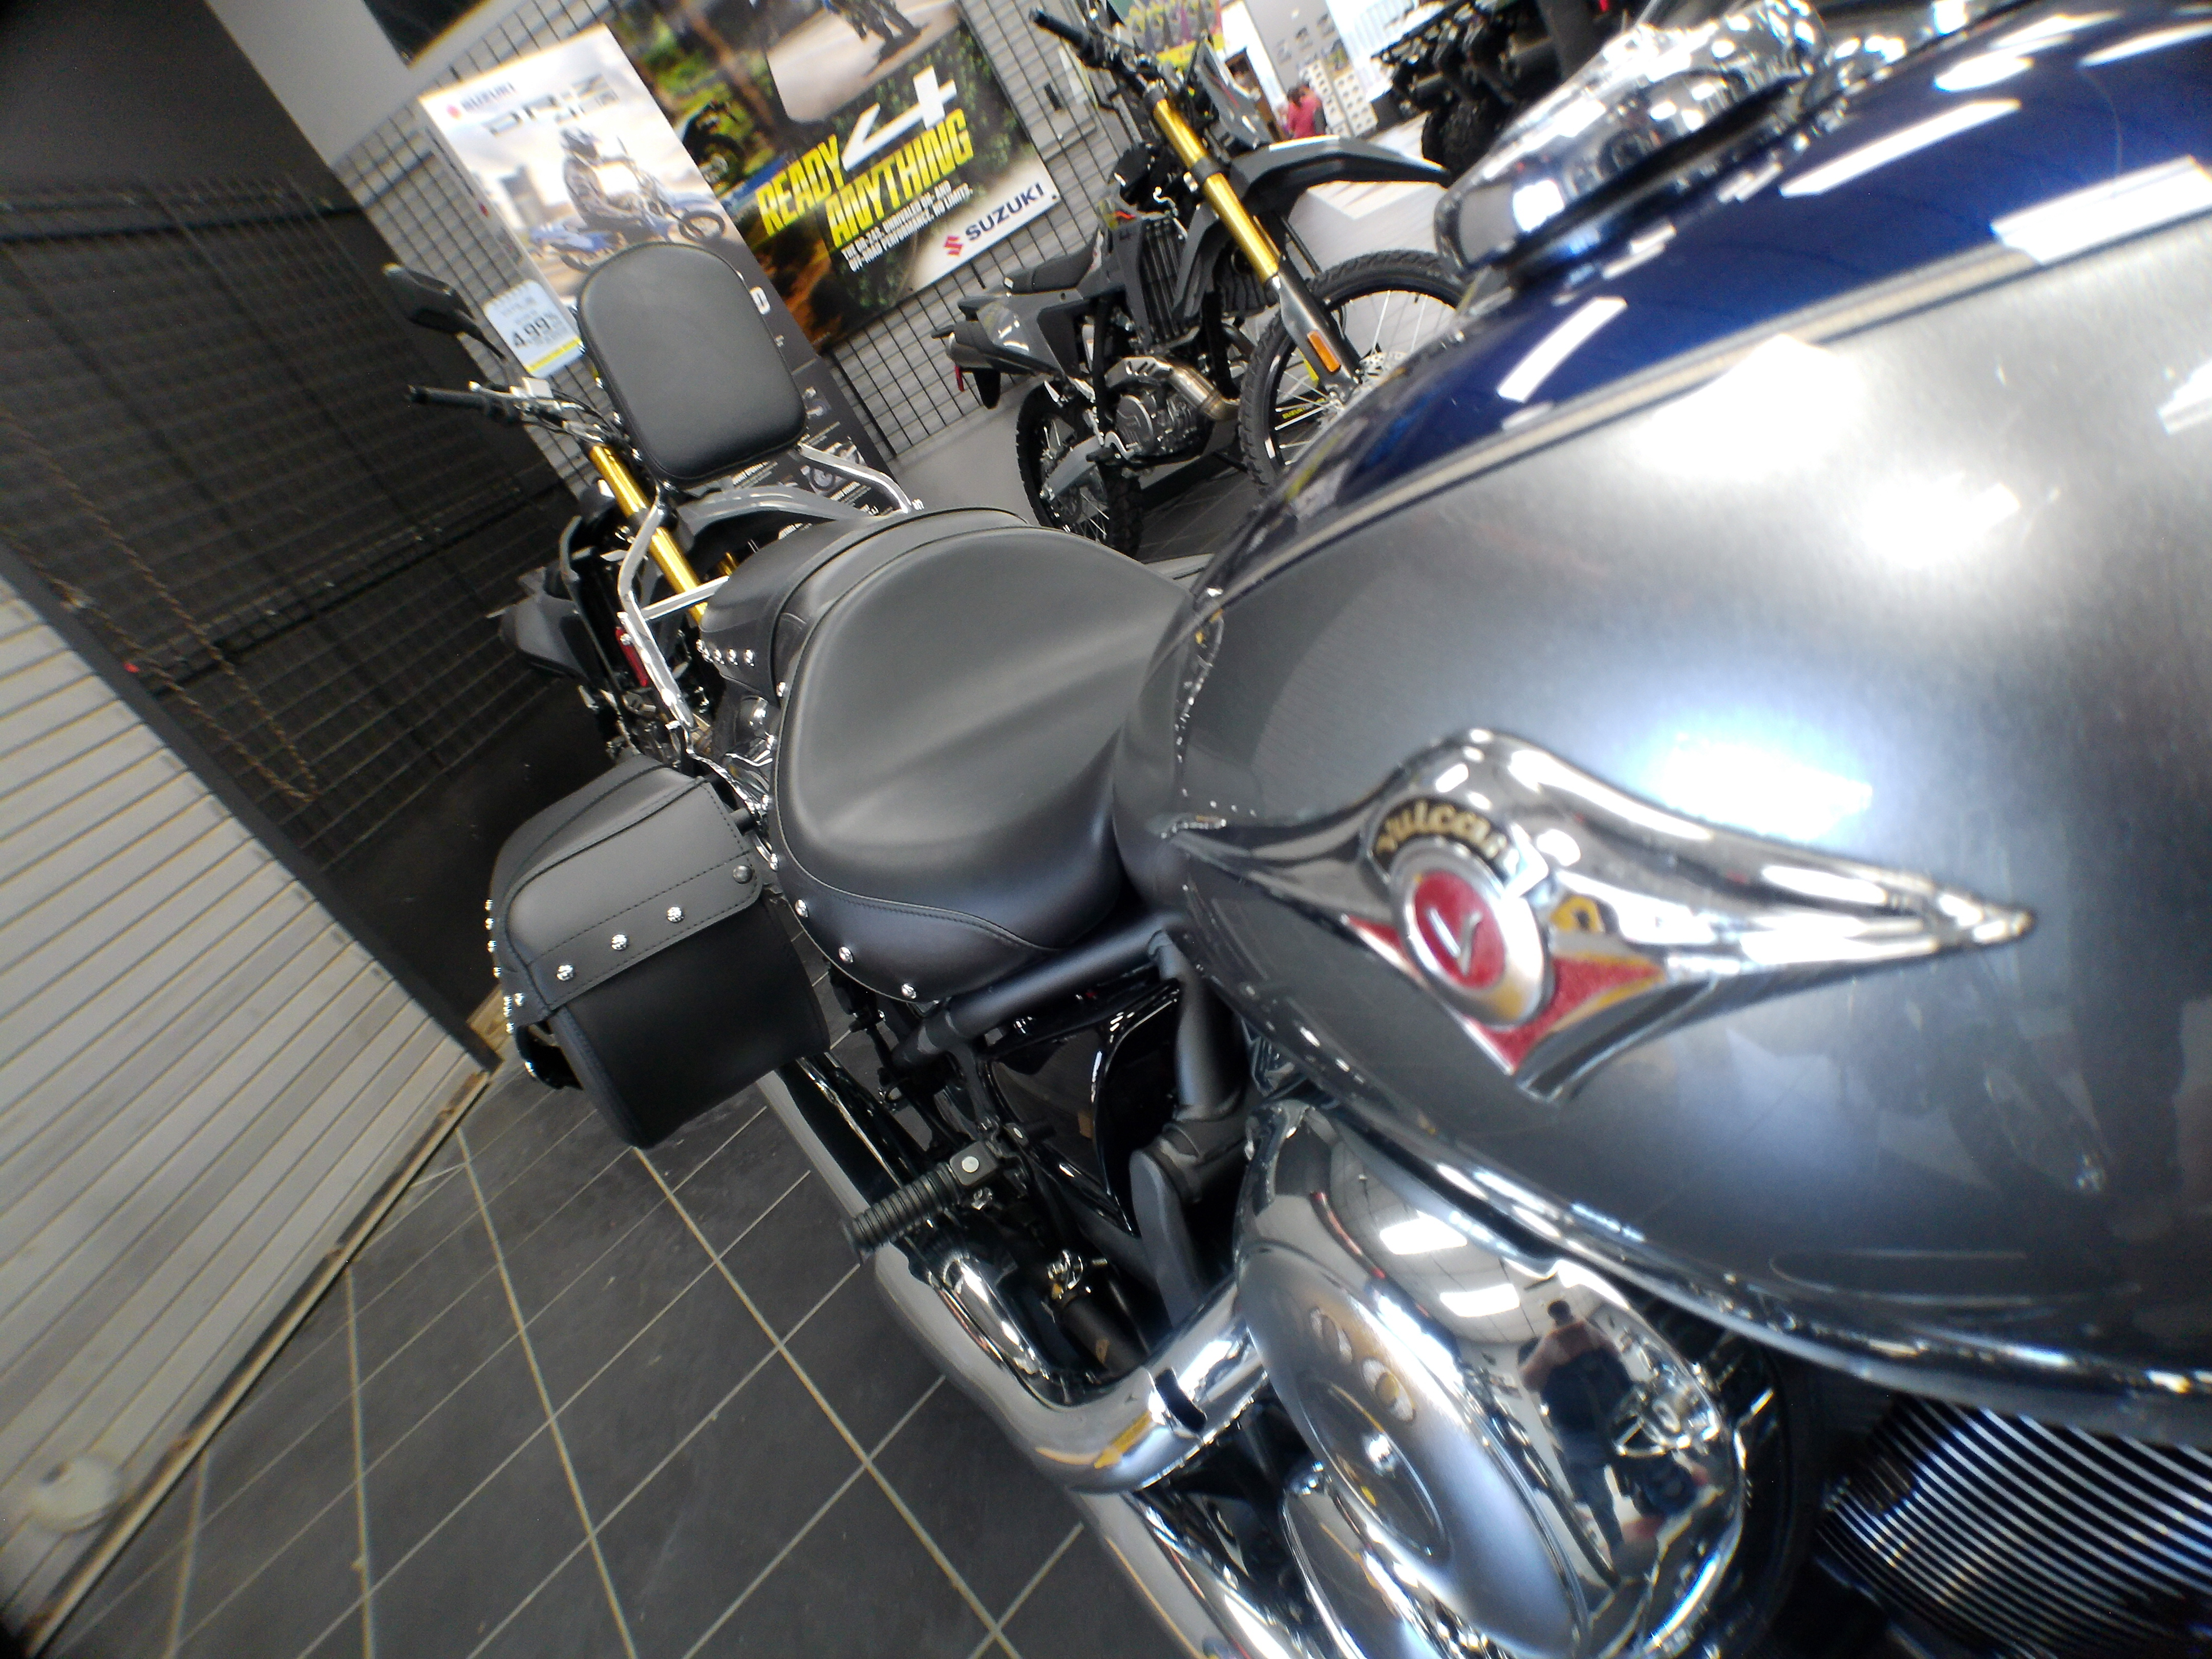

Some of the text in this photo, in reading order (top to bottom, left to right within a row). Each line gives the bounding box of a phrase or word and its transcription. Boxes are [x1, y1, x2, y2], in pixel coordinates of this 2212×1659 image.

[756, 134, 844, 236] READY
[825, 109, 973, 248] ANYTHING
[966, 183, 1044, 241] SUZUKI
